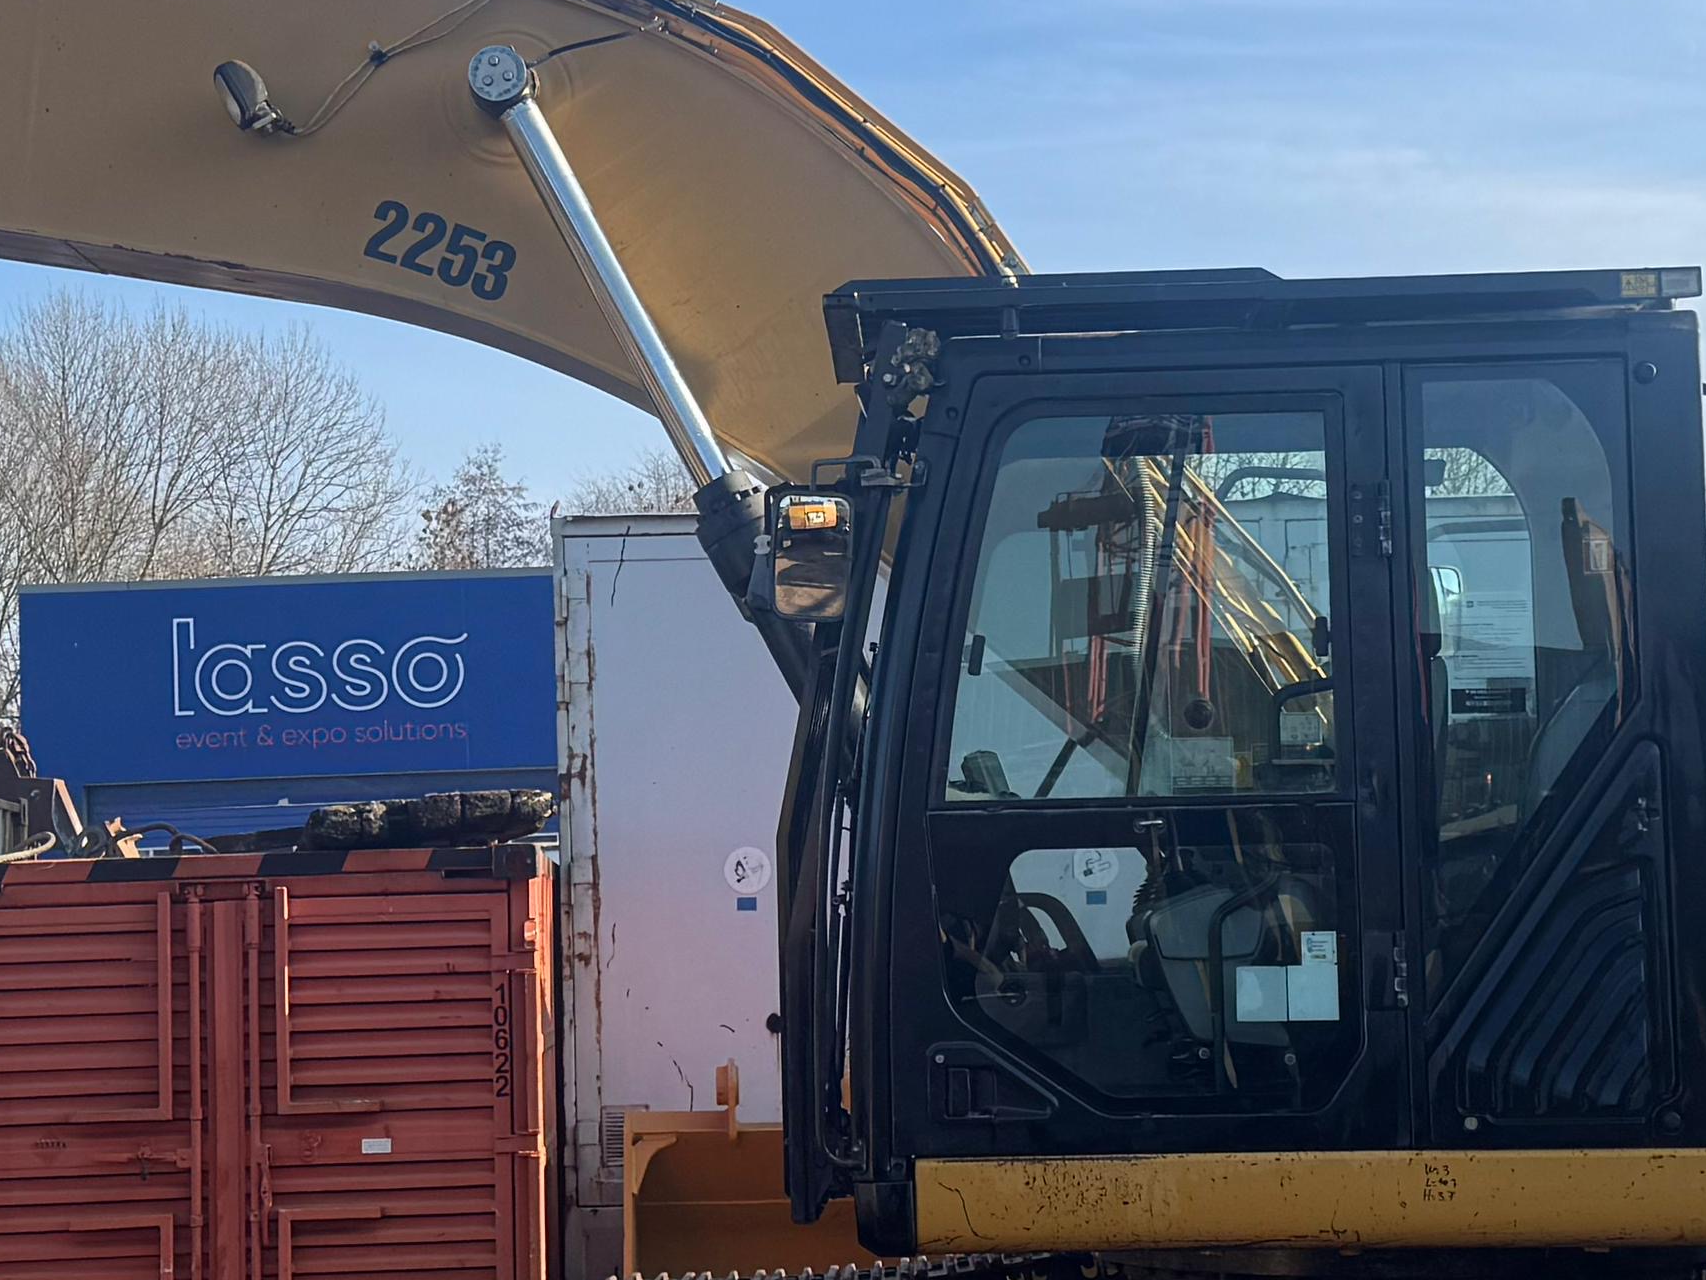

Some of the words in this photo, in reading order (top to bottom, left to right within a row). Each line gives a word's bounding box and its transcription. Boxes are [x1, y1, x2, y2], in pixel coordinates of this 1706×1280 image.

[364, 200, 517, 301] 2253
[173, 618, 468, 716] lasso
[175, 729, 247, 749] event
[256, 724, 274, 746] &
[282, 726, 346, 749] expo
[355, 720, 468, 743] solutions
[494, 983, 510, 1098] 10622
